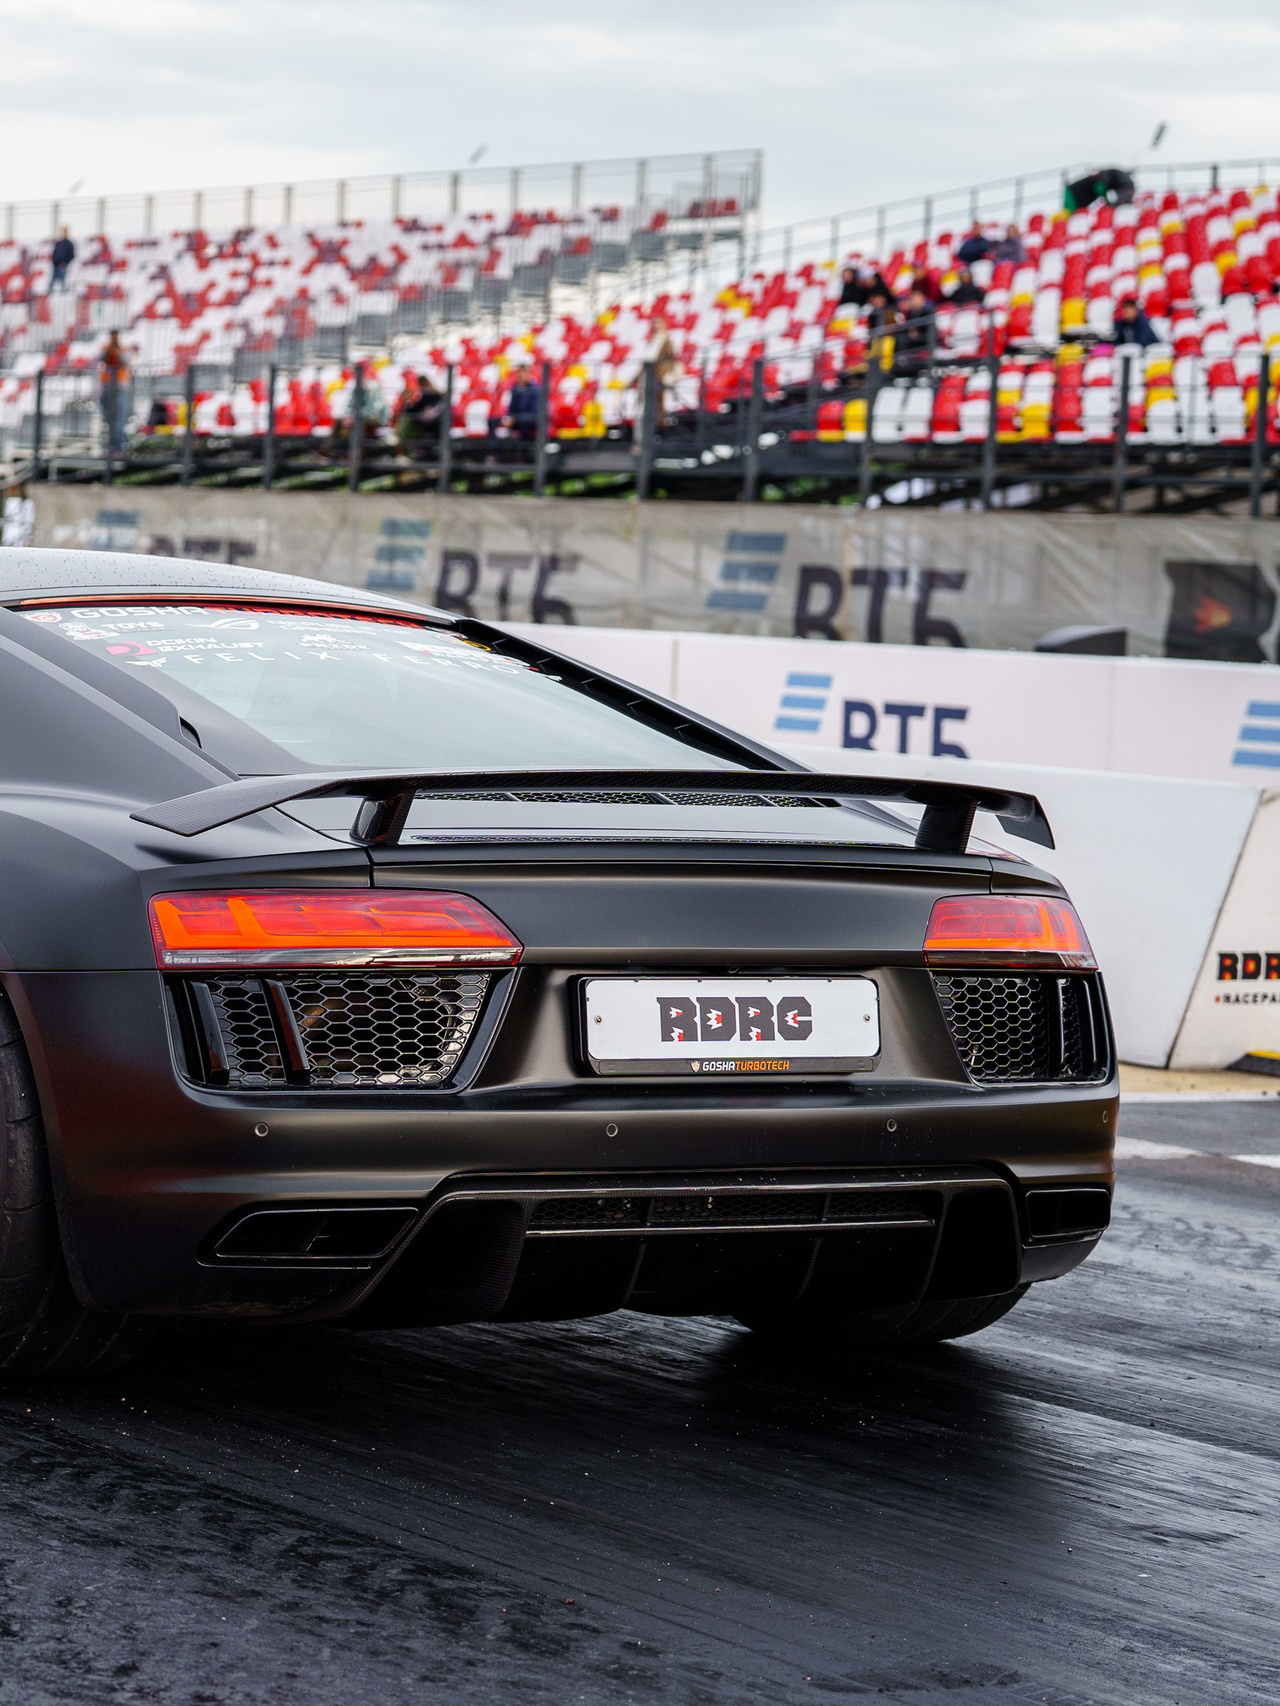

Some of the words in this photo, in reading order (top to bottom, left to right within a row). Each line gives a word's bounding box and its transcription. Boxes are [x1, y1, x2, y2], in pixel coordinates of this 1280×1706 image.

[183, 651, 342, 665] FELIX
[656, 996, 813, 1042] RDRC
[702, 1061, 790, 1071] GOSHATURBOTECH
